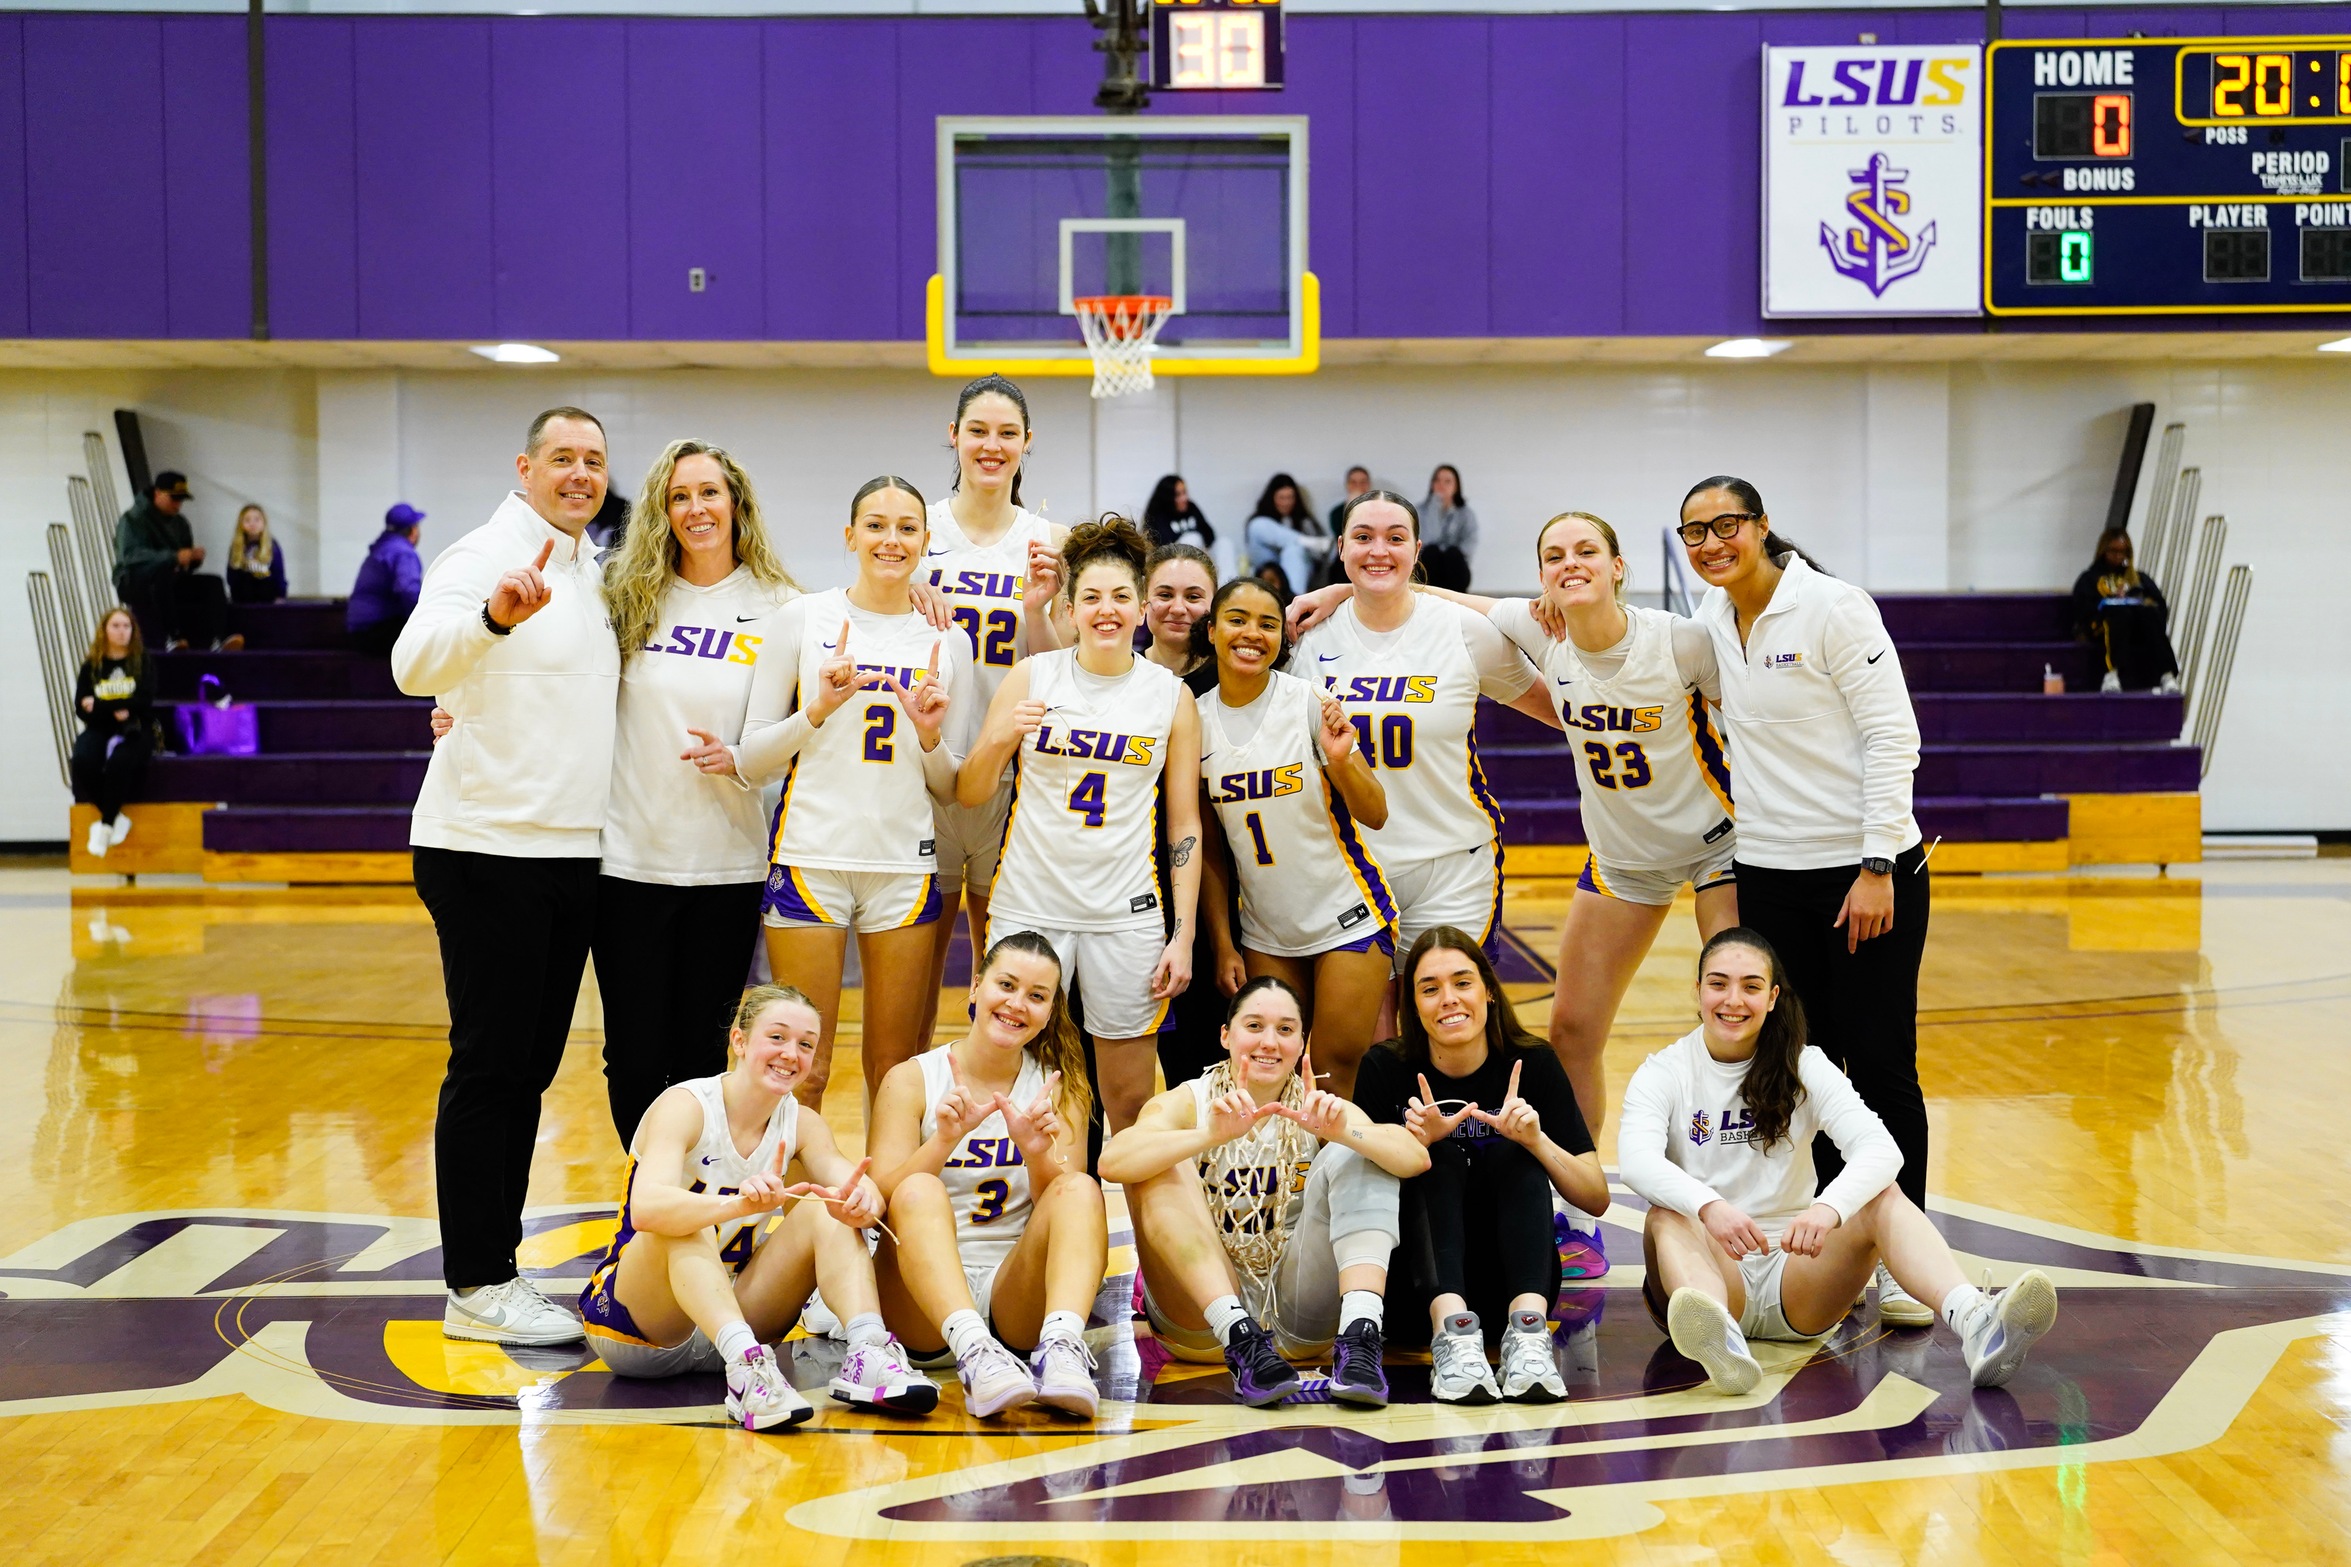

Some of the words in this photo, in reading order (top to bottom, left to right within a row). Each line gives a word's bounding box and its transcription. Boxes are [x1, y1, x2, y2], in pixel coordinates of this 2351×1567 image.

[1174, 15, 1260, 84] 30
[2034, 51, 2134, 87] HOME
[1782, 58, 1970, 107] LSUS
[1789, 115, 1956, 136] PILOTS
[2094, 95, 2130, 157] 0
[2205, 126, 2248, 145] POSS
[2063, 167, 2135, 191] BONUS
[2252, 150, 2330, 175] PERIOD
[2026, 206, 2094, 230] FOULS
[2190, 204, 2268, 227] PLAYER
[2061, 231, 2091, 282] 0
[1776, 653, 1802, 663] LSUS
[862, 703, 896, 765] 2
[1562, 698, 1664, 733] LSUS
[1034, 725, 1157, 767] LSUS
[1582, 739, 1654, 792] 23
[1066, 769, 1109, 830] 4
[1200, 761, 1303, 804] LSUS
[1243, 810, 1276, 868] 1
[970, 1177, 1012, 1225] 3
[714, 1223, 758, 1274] 4
